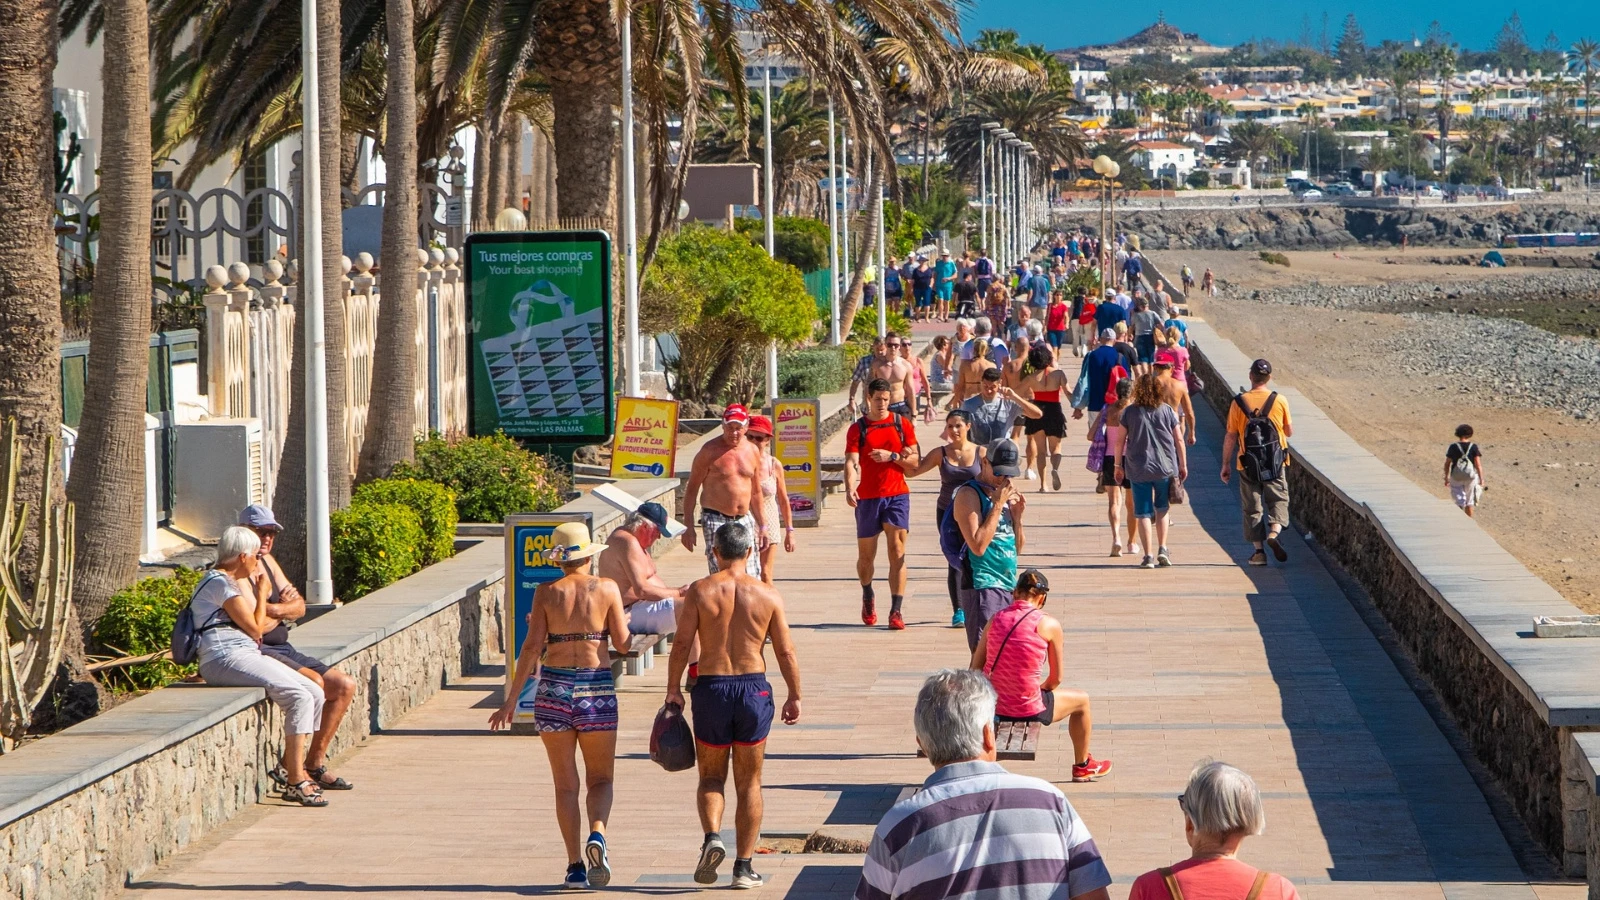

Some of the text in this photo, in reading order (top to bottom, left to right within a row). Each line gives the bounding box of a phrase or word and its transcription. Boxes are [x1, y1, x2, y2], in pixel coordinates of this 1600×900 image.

[479, 250, 593, 265] Tus mejores compras
[489, 264, 583, 276] Your best shopping
[777, 408, 814, 421] ARISAL
[555, 425, 584, 433] PALMAS
[622, 417, 668, 432] ARISAL
[617, 445, 671, 456] AUTOVERMIETUNG
[633, 464, 649, 472] info
[524, 535, 554, 552] AQU
[524, 552, 560, 567] LAN
